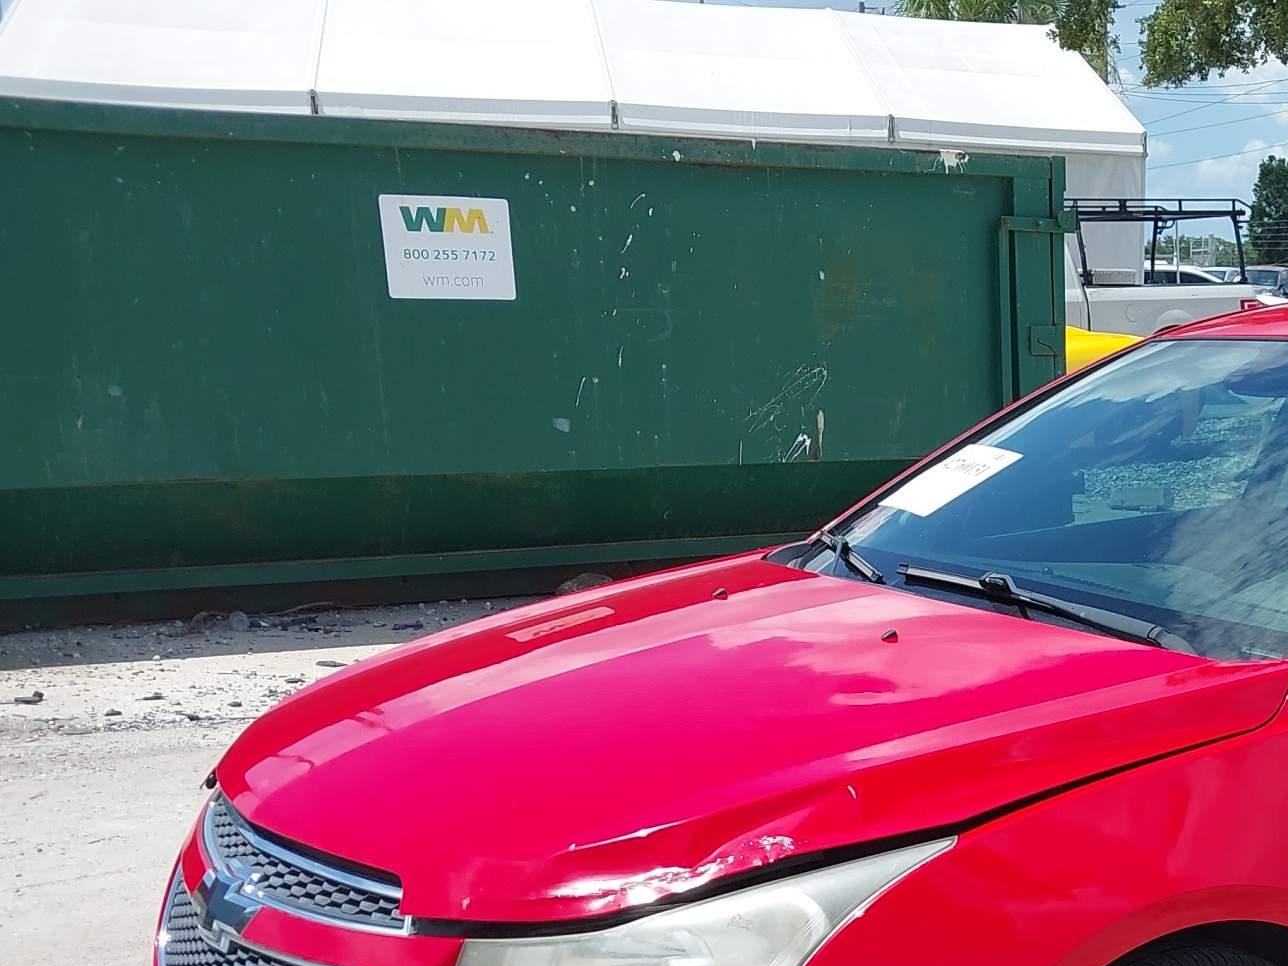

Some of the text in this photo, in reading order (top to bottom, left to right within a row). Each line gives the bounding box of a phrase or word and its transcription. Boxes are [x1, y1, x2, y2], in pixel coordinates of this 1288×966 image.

[399, 206, 489, 234] WM
[403, 248, 496, 262] 800 255 7172
[422, 274, 485, 288] wm.com
